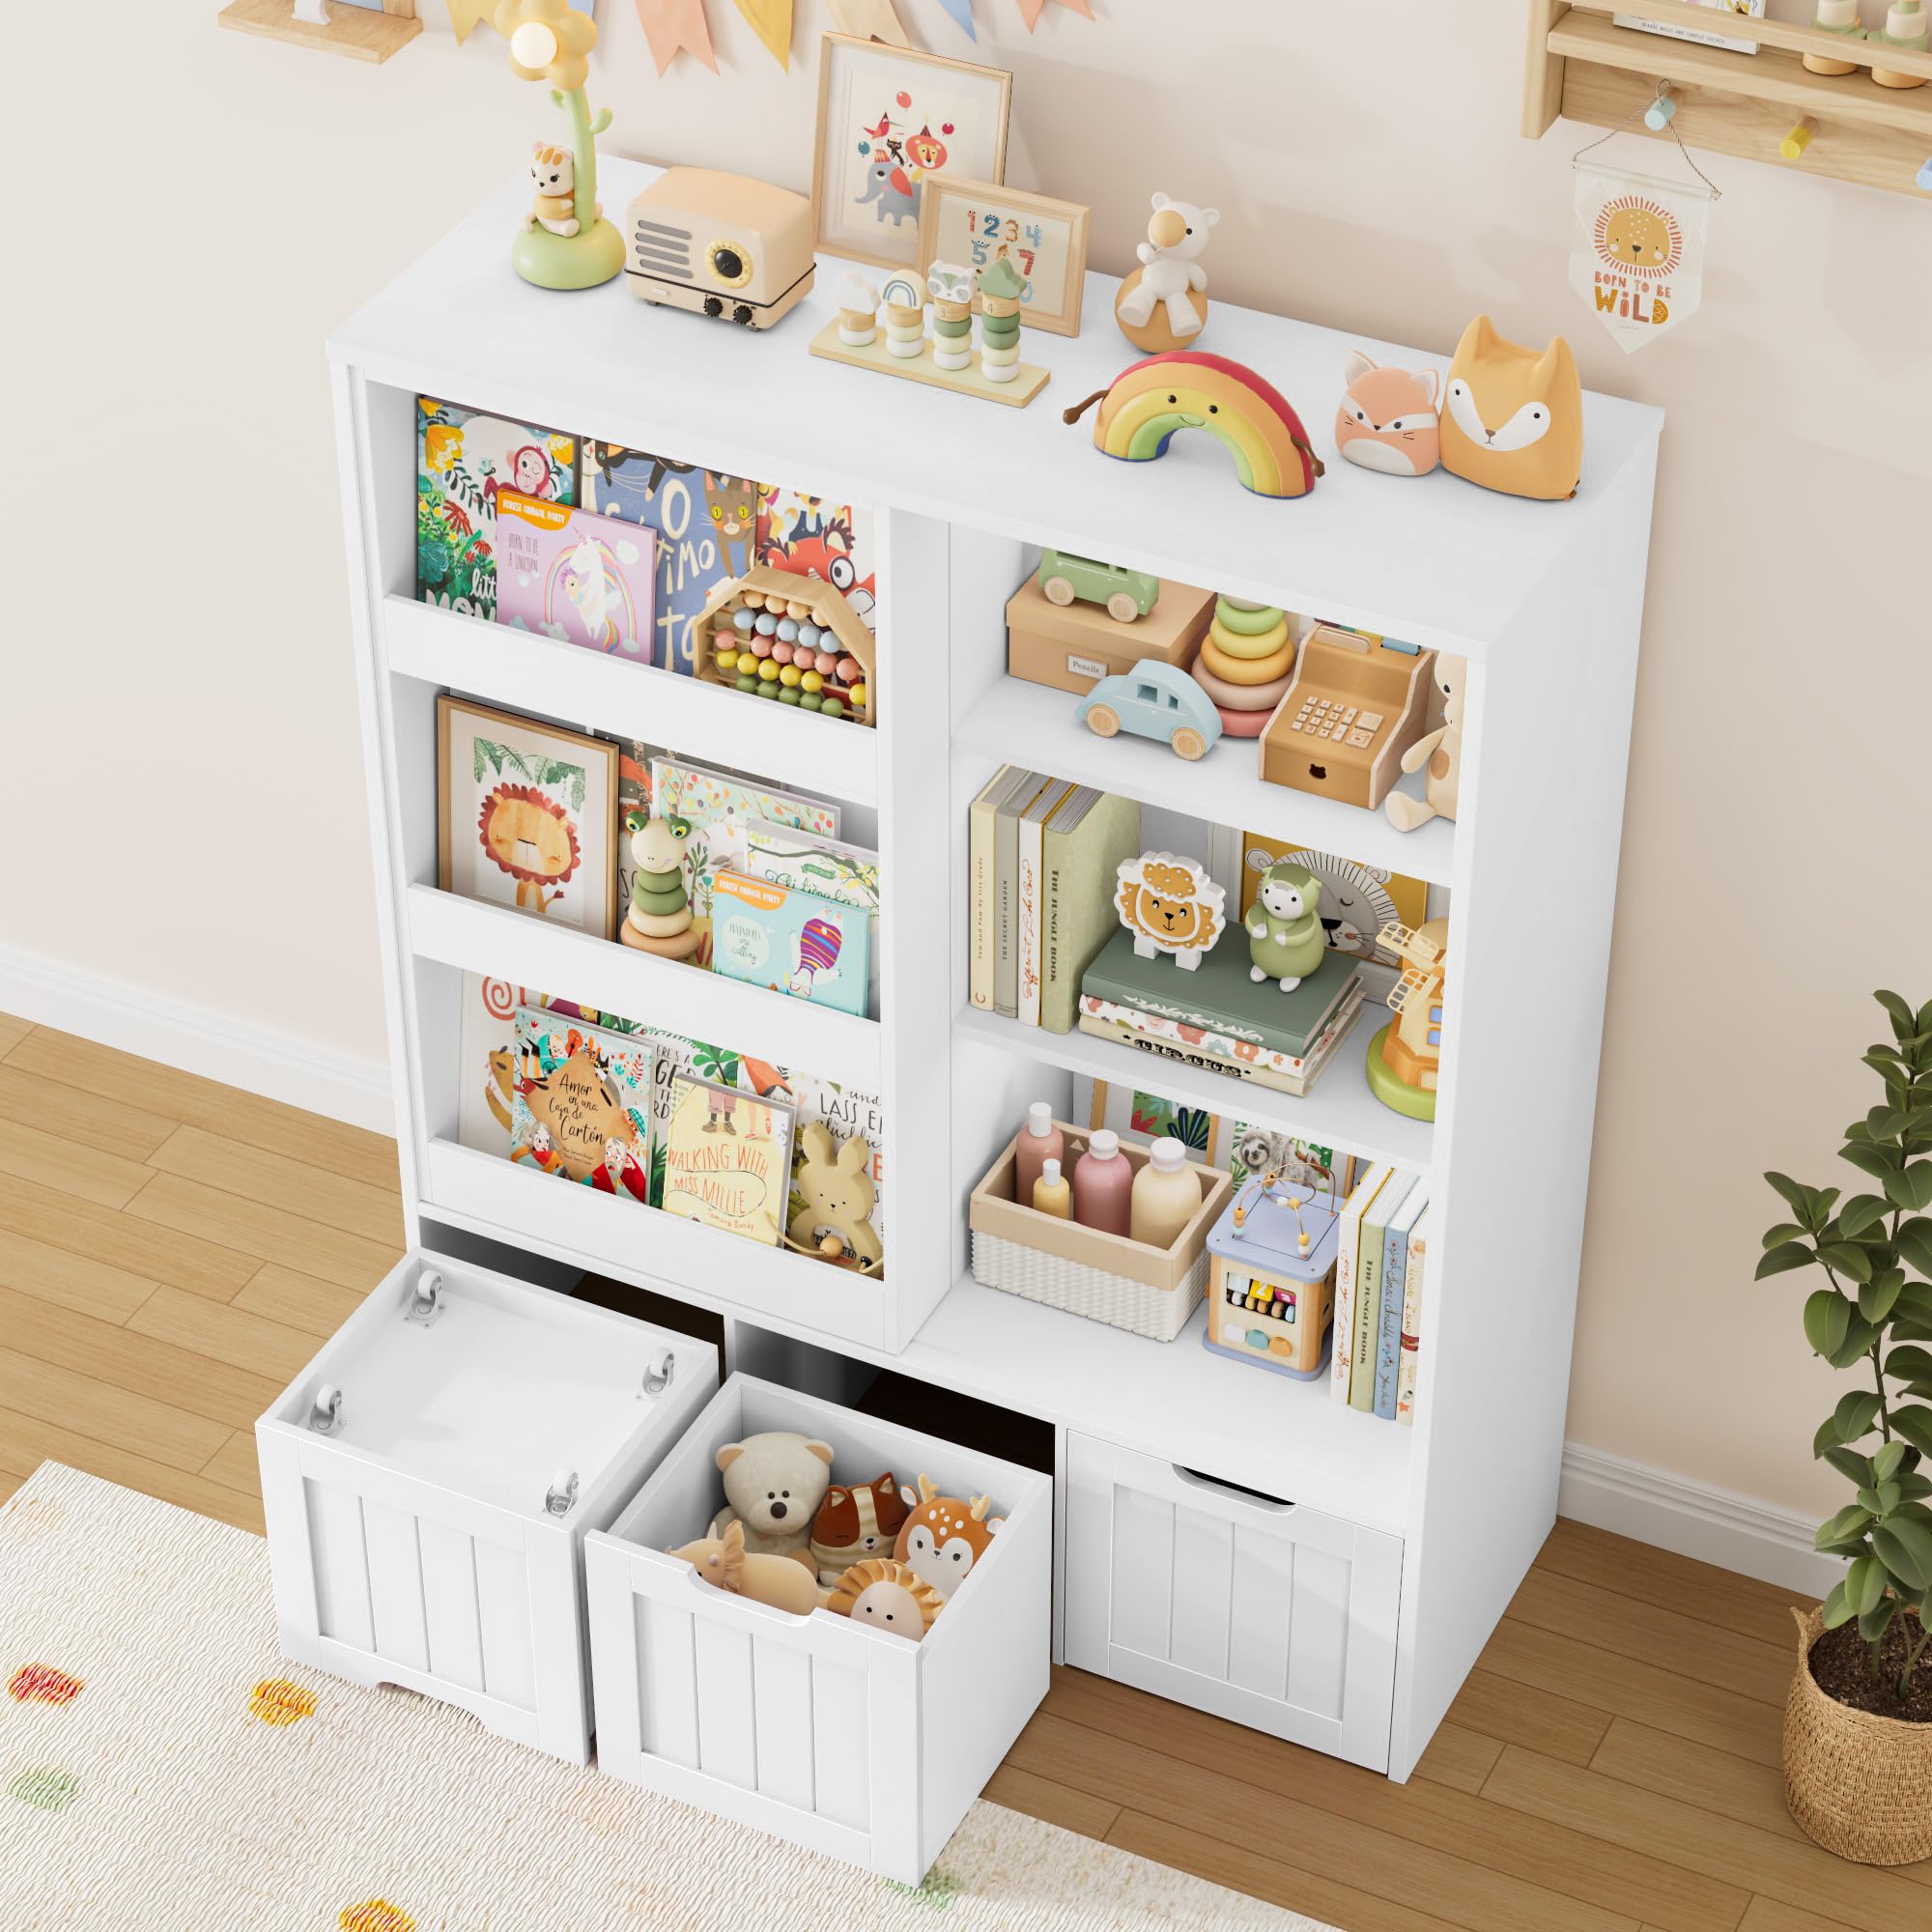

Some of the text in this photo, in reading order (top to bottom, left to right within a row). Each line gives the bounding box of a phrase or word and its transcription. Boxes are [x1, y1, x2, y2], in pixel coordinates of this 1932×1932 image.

[967, 210, 1042, 248] 1 2 3 4
[971, 239, 1036, 275] 5 7
[1634, 279, 1650, 293] TO
[1657, 284, 1671, 298] BE
[509, 532, 539, 555] BORN TO BE
[515, 554, 538, 573] UNICORN
[469, 568, 497, 600] litt
[1073, 661, 1099, 673] Pencils
[1134, 1038, 1242, 1078] CIRCUS
[557, 1073, 592, 1096] Amor
[549, 1097, 582, 1121] Caja de
[568, 1096, 599, 1112] en una
[820, 1093, 858, 1124] LASS
[560, 1116, 606, 1146] Cartón
[668, 1143, 769, 1179] WALKING WITH
[674, 1176, 746, 1214] MISS MILLIE
[734, 1219, 756, 1232] Bundy
[1257, 1281, 1267, 1296] 2
[1361, 1286, 1371, 1327] JUNGLE
[1359, 1331, 1369, 1365] BOOK
